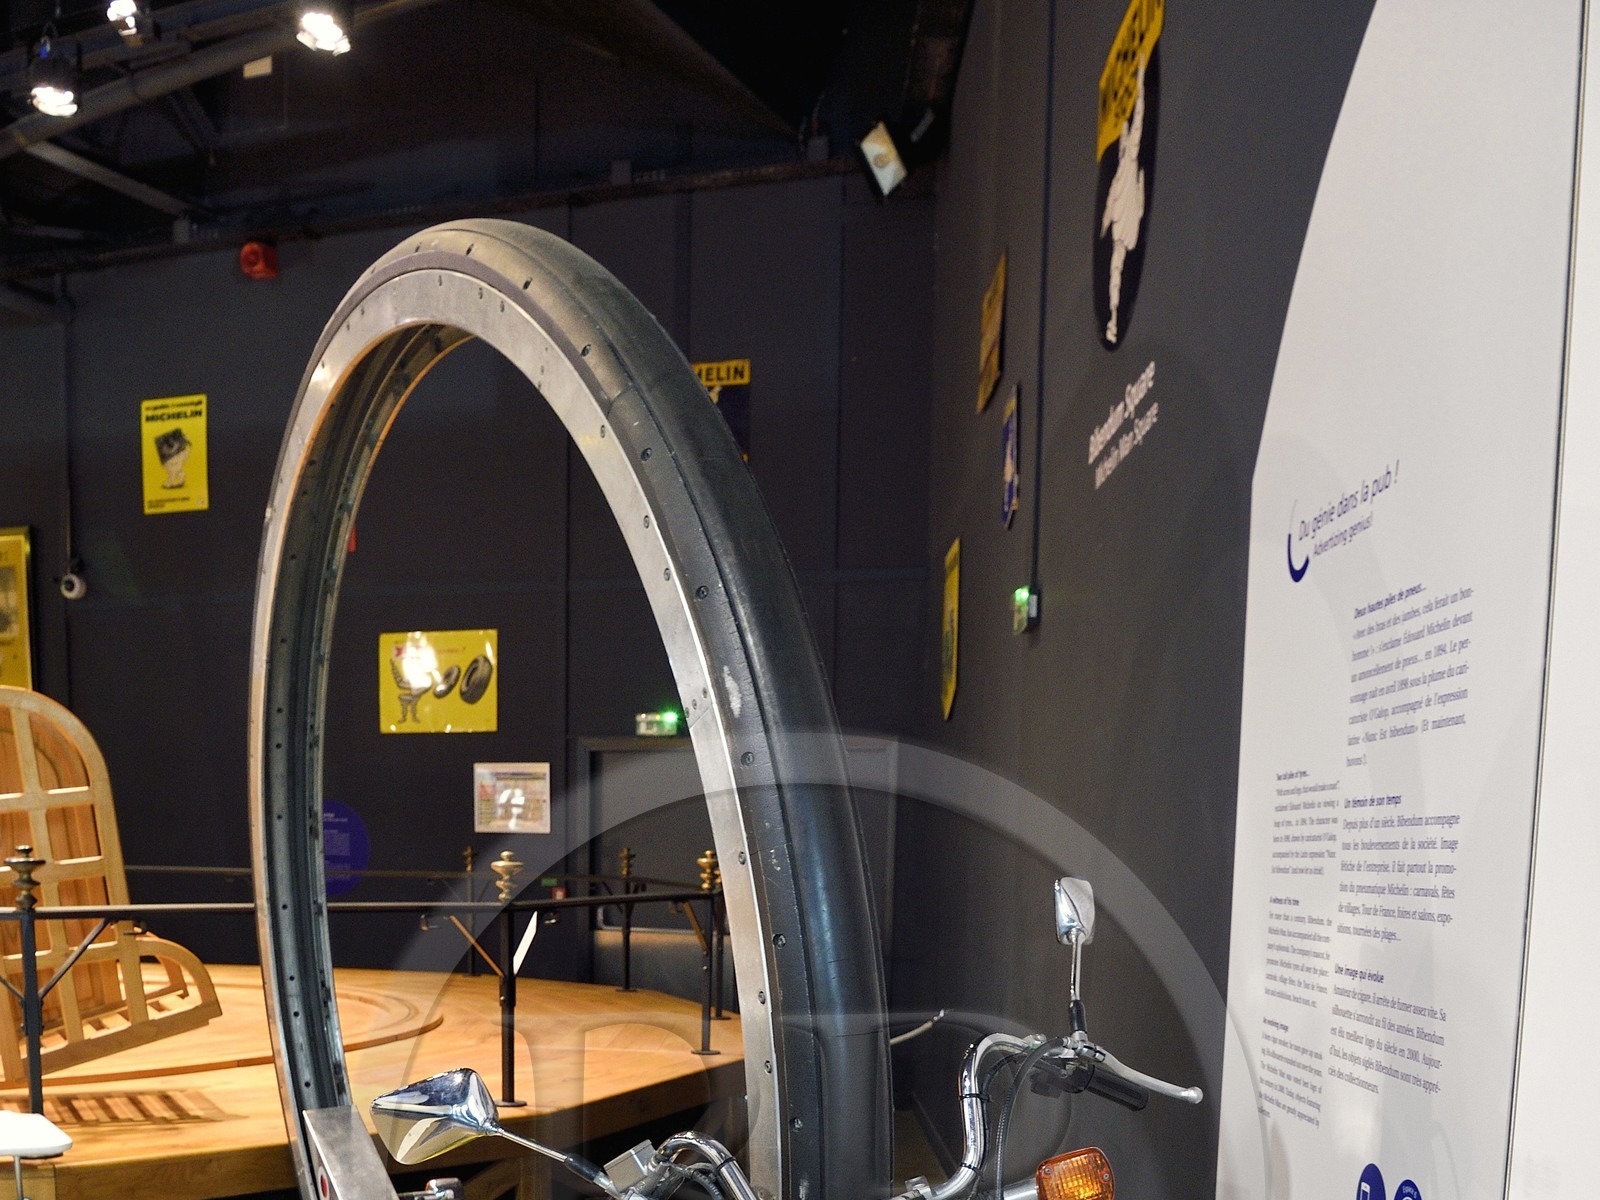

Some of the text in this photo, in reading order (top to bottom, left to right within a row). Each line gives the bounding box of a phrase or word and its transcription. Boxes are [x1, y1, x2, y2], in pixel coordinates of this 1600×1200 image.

[1124, 361, 1155, 419] Square
[146, 409, 202, 422] MICHELIN
[1133, 402, 1158, 446] Square
[1299, 459, 1400, 541] Du génie dans la pub !
[1354, 583, 1426, 619] Deux hautes piles de pneus...
[1344, 795, 1401, 809] Un témoin de son temps
[1334, 963, 1384, 983] Une image qui évolue
